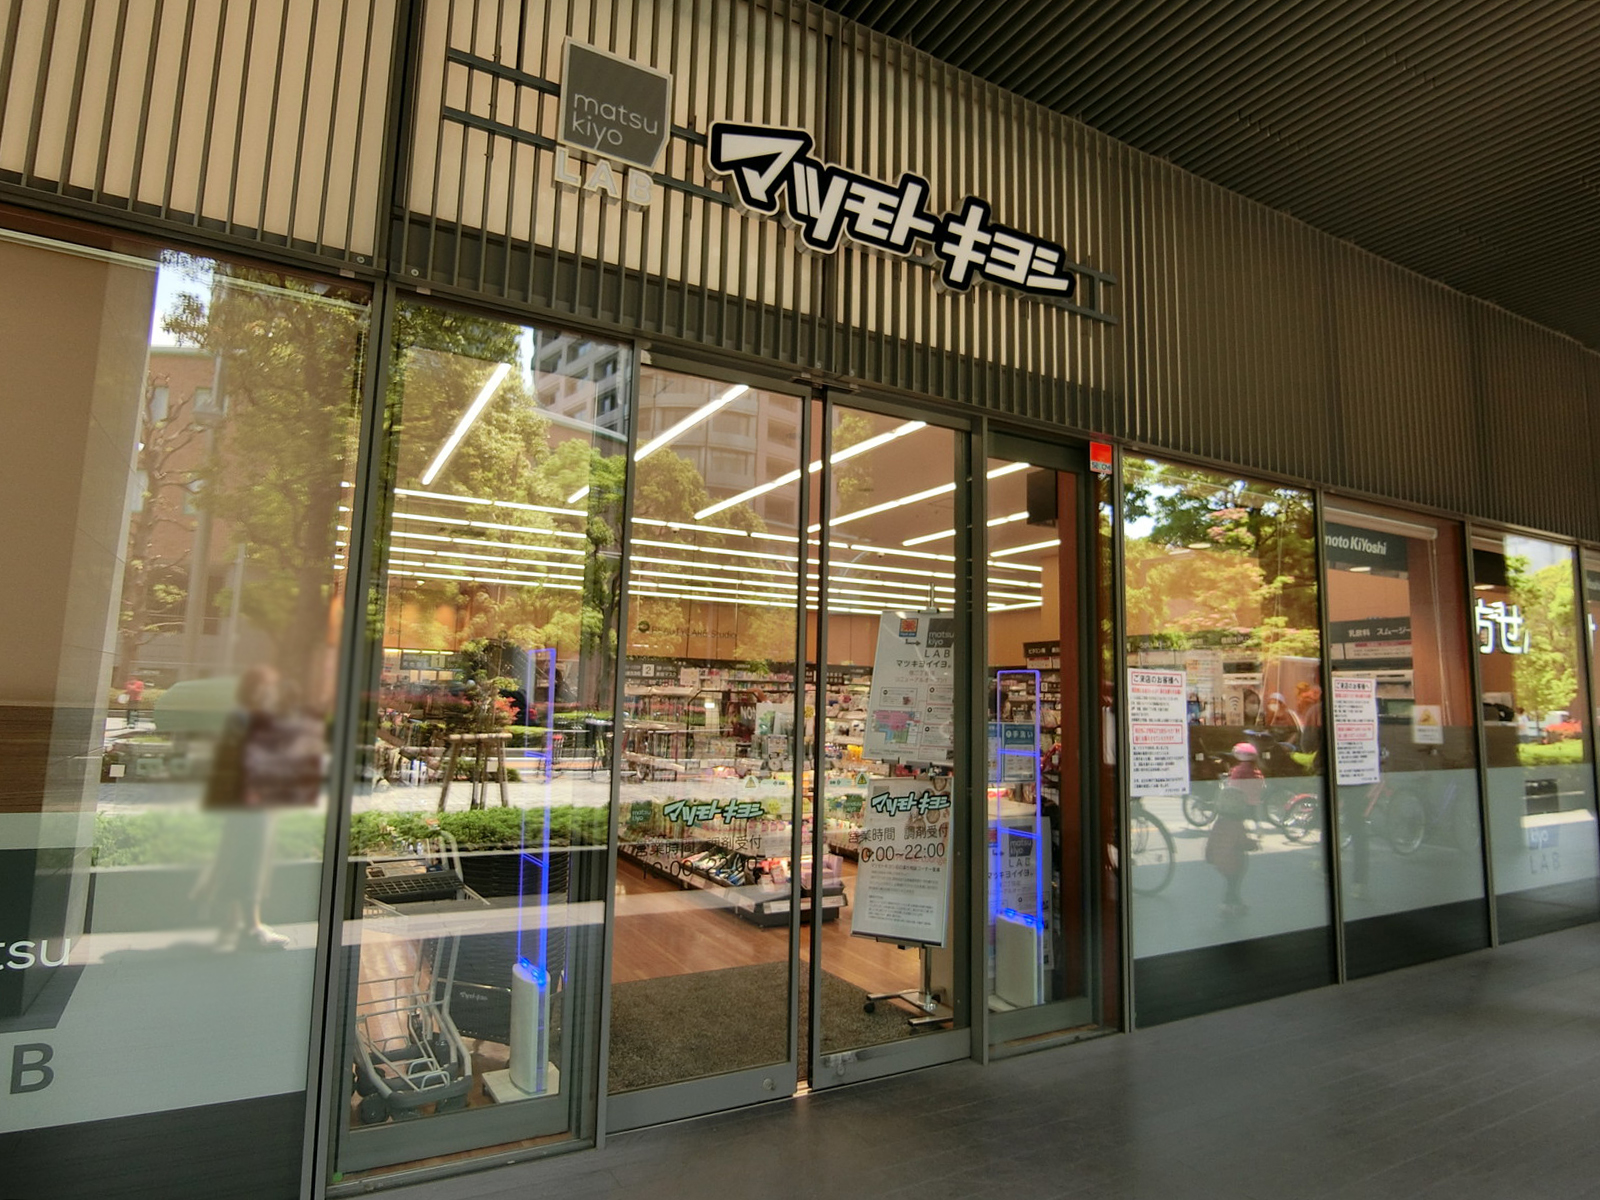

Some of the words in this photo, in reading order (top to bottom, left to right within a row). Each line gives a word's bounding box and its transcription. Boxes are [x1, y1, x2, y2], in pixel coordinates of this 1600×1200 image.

[573, 92, 658, 135] matsu
[572, 111, 623, 150] kiyo
[554, 146, 655, 209] LAB
[710, 122, 1076, 299] マツモトキヨシ
[1350, 536, 1387, 555] KiYoshi
[924, 650, 951, 659] LAB
[663, 799, 765, 827] マツモトキヨシ
[870, 791, 952, 817] マツモトキヨシ
[903, 824, 948, 841] 調剤受付
[10, 1042, 55, 1095] B
